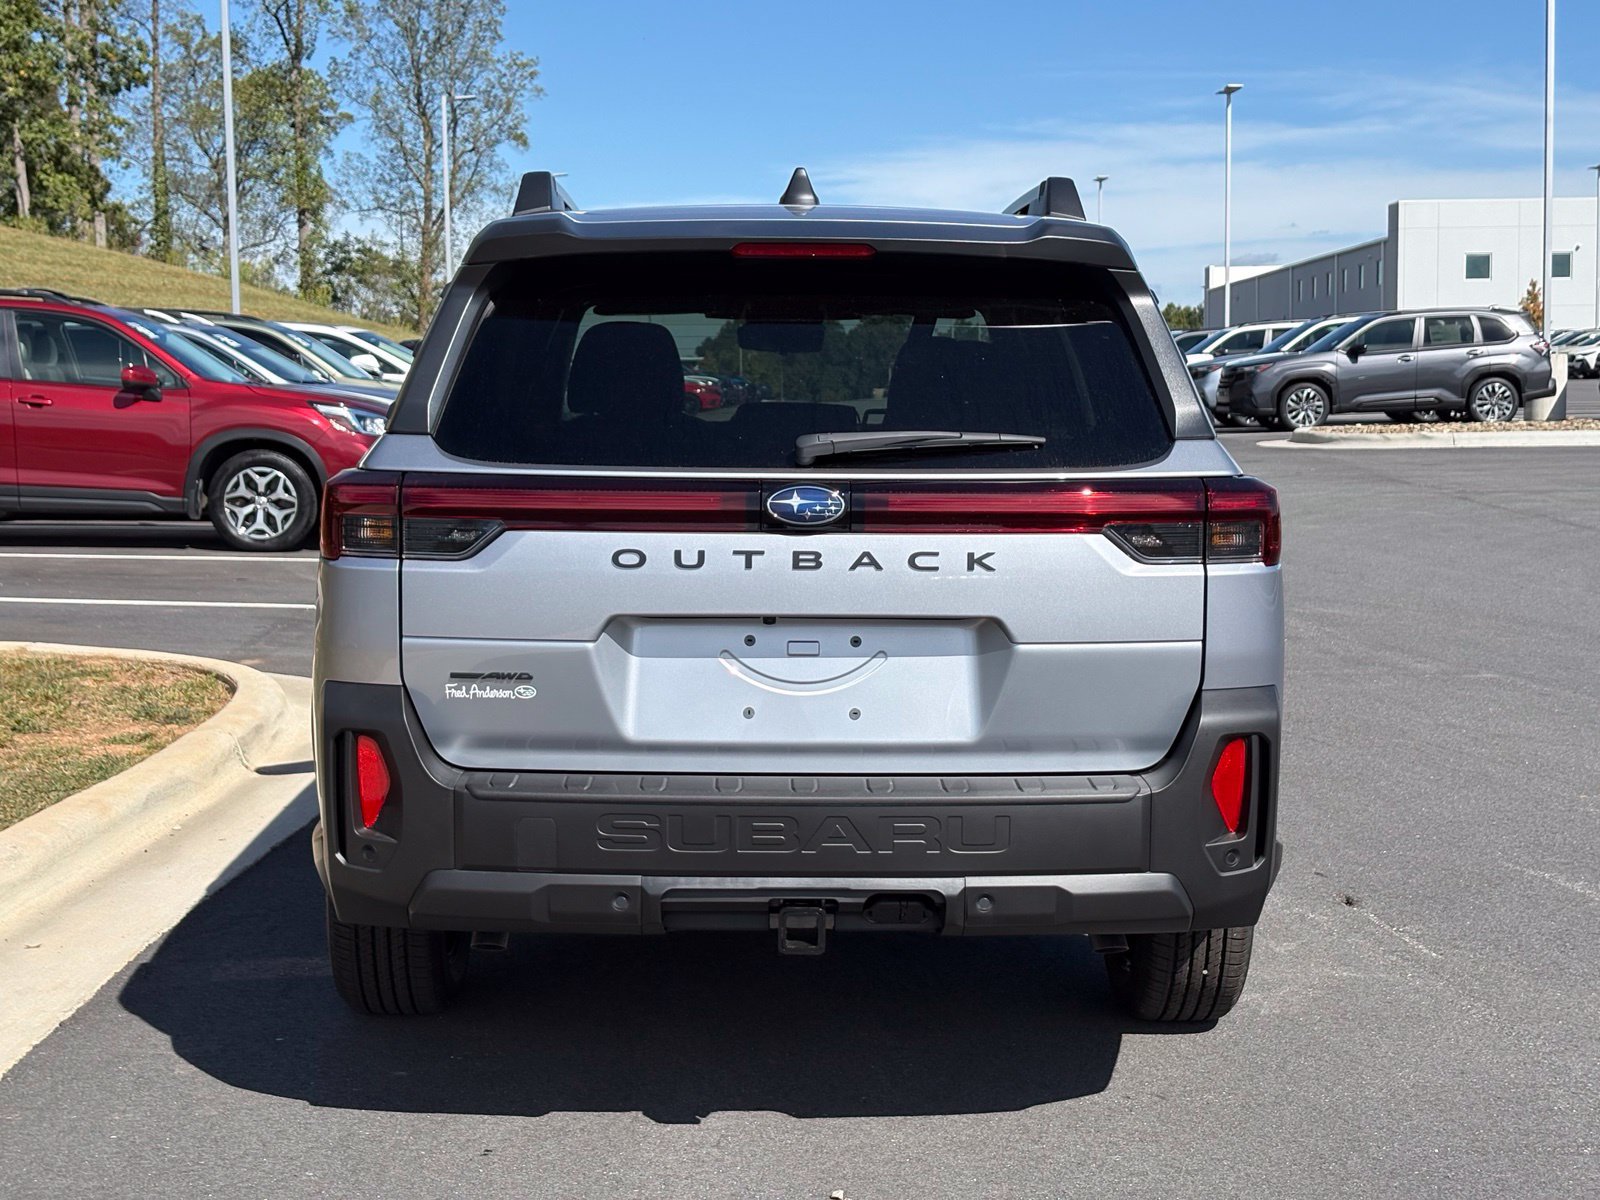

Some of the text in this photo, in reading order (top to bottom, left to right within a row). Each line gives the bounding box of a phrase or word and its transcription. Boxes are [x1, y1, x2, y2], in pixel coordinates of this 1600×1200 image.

[611, 548, 997, 572] OUTBACK
[480, 671, 534, 680] AWD
[445, 683, 516, 699] Fred Anderson
[596, 813, 1011, 855] SUBARU
